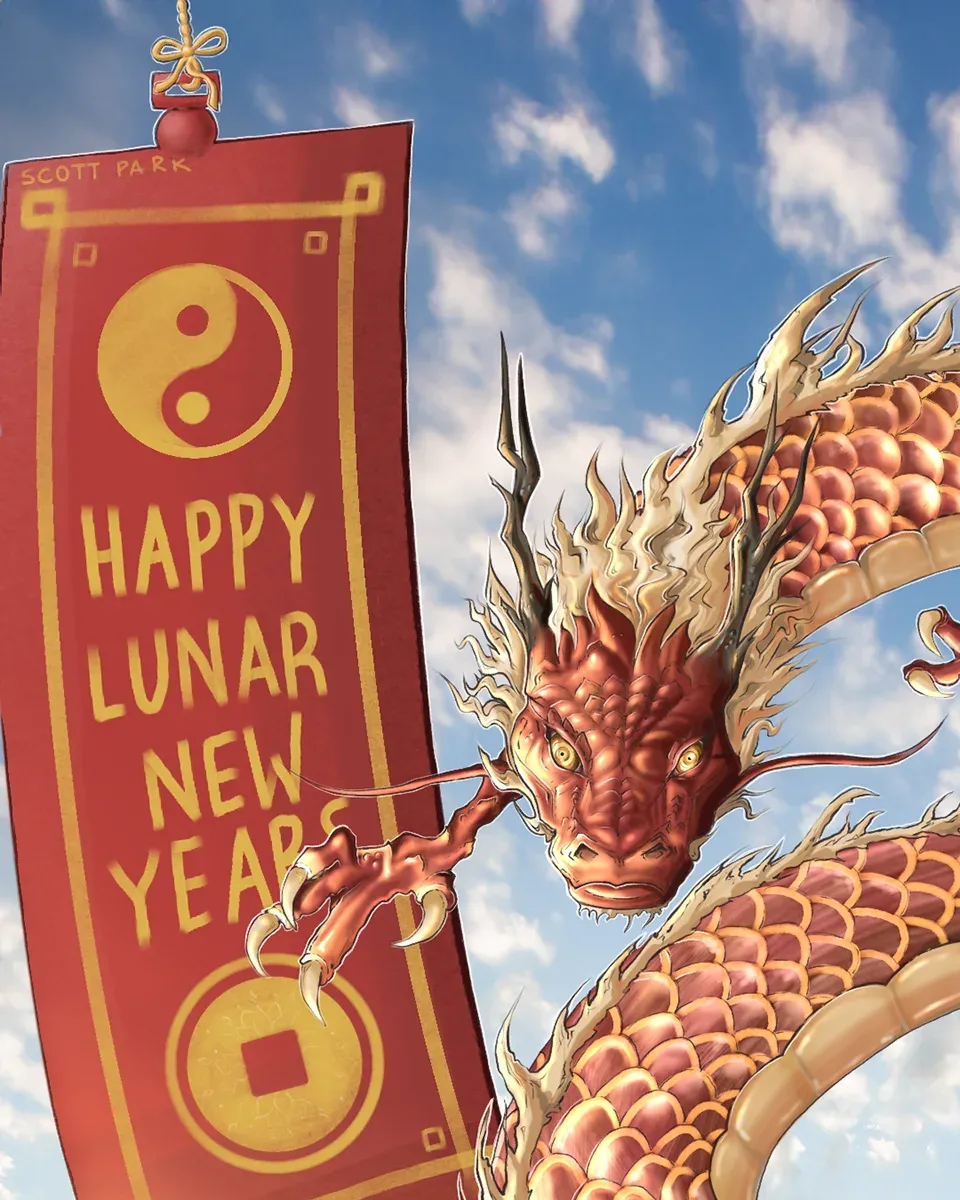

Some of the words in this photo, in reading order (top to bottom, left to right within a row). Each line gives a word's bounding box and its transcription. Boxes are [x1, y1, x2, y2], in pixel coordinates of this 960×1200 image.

[21, 161, 101, 186] SCOTT
[116, 155, 192, 178] PARK
[81, 491, 316, 598] HAPPY
[86, 610, 328, 723] LUNAR
[142, 711, 302, 831] NEW
